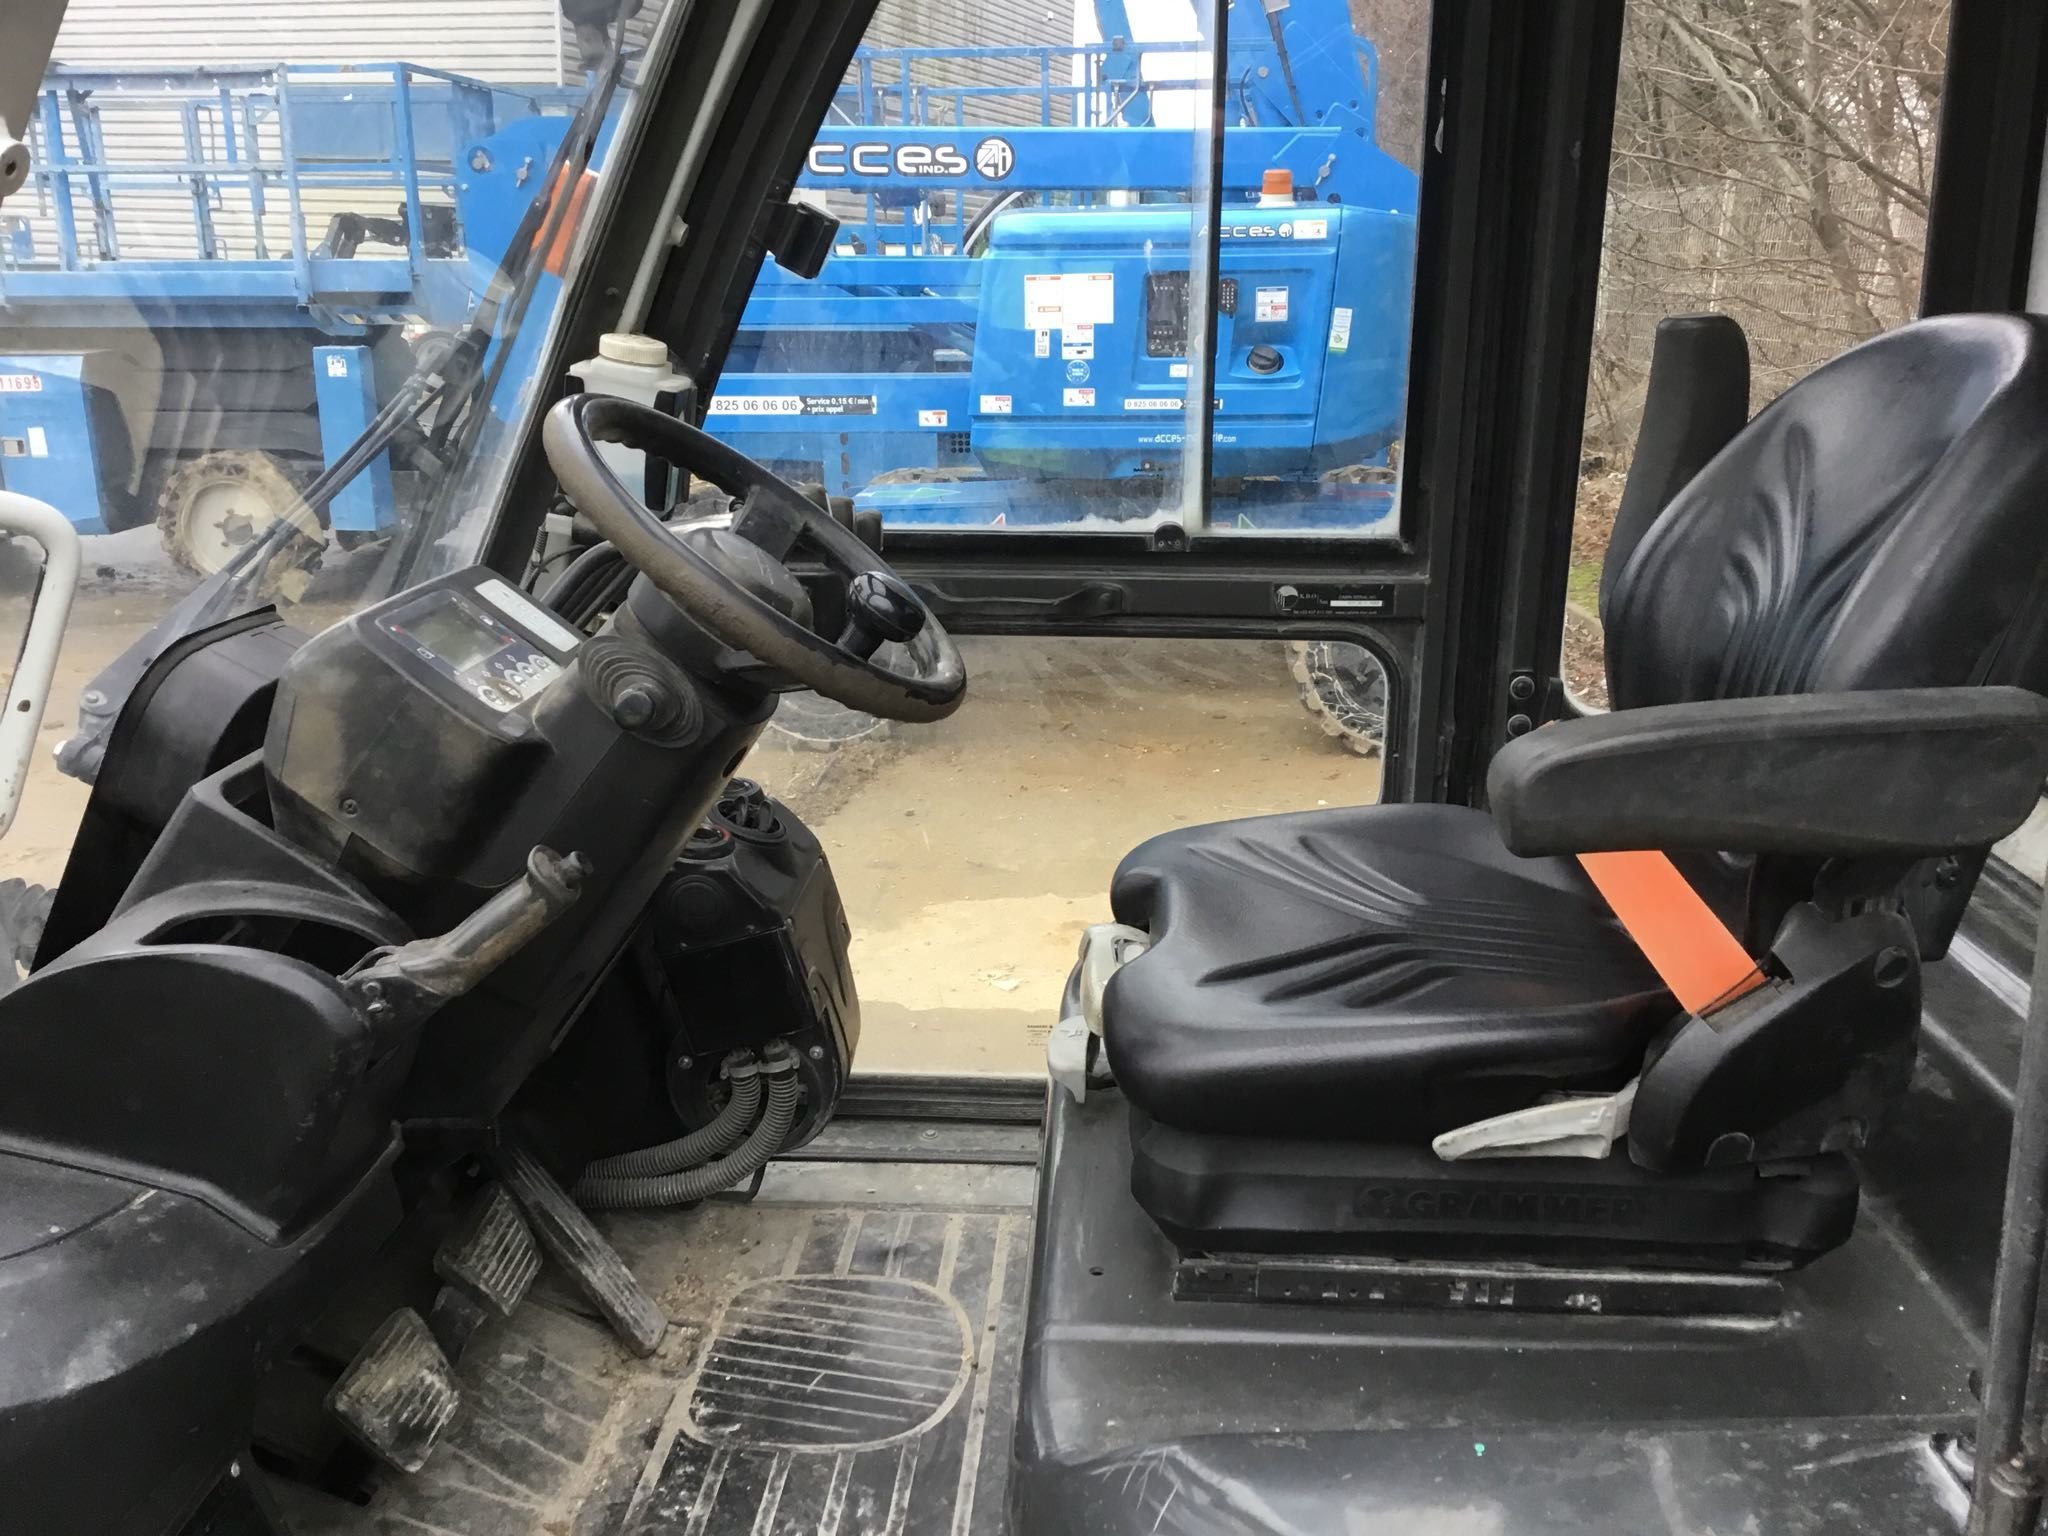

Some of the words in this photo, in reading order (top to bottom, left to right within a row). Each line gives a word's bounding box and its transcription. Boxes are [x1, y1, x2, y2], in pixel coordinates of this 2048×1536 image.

[808, 144, 968, 174] cces
[716, 400, 739, 411] 825
[743, 400, 759, 411] 06
[762, 400, 778, 411] 06
[782, 400, 798, 411] 06
[806, 397, 831, 405] Service
